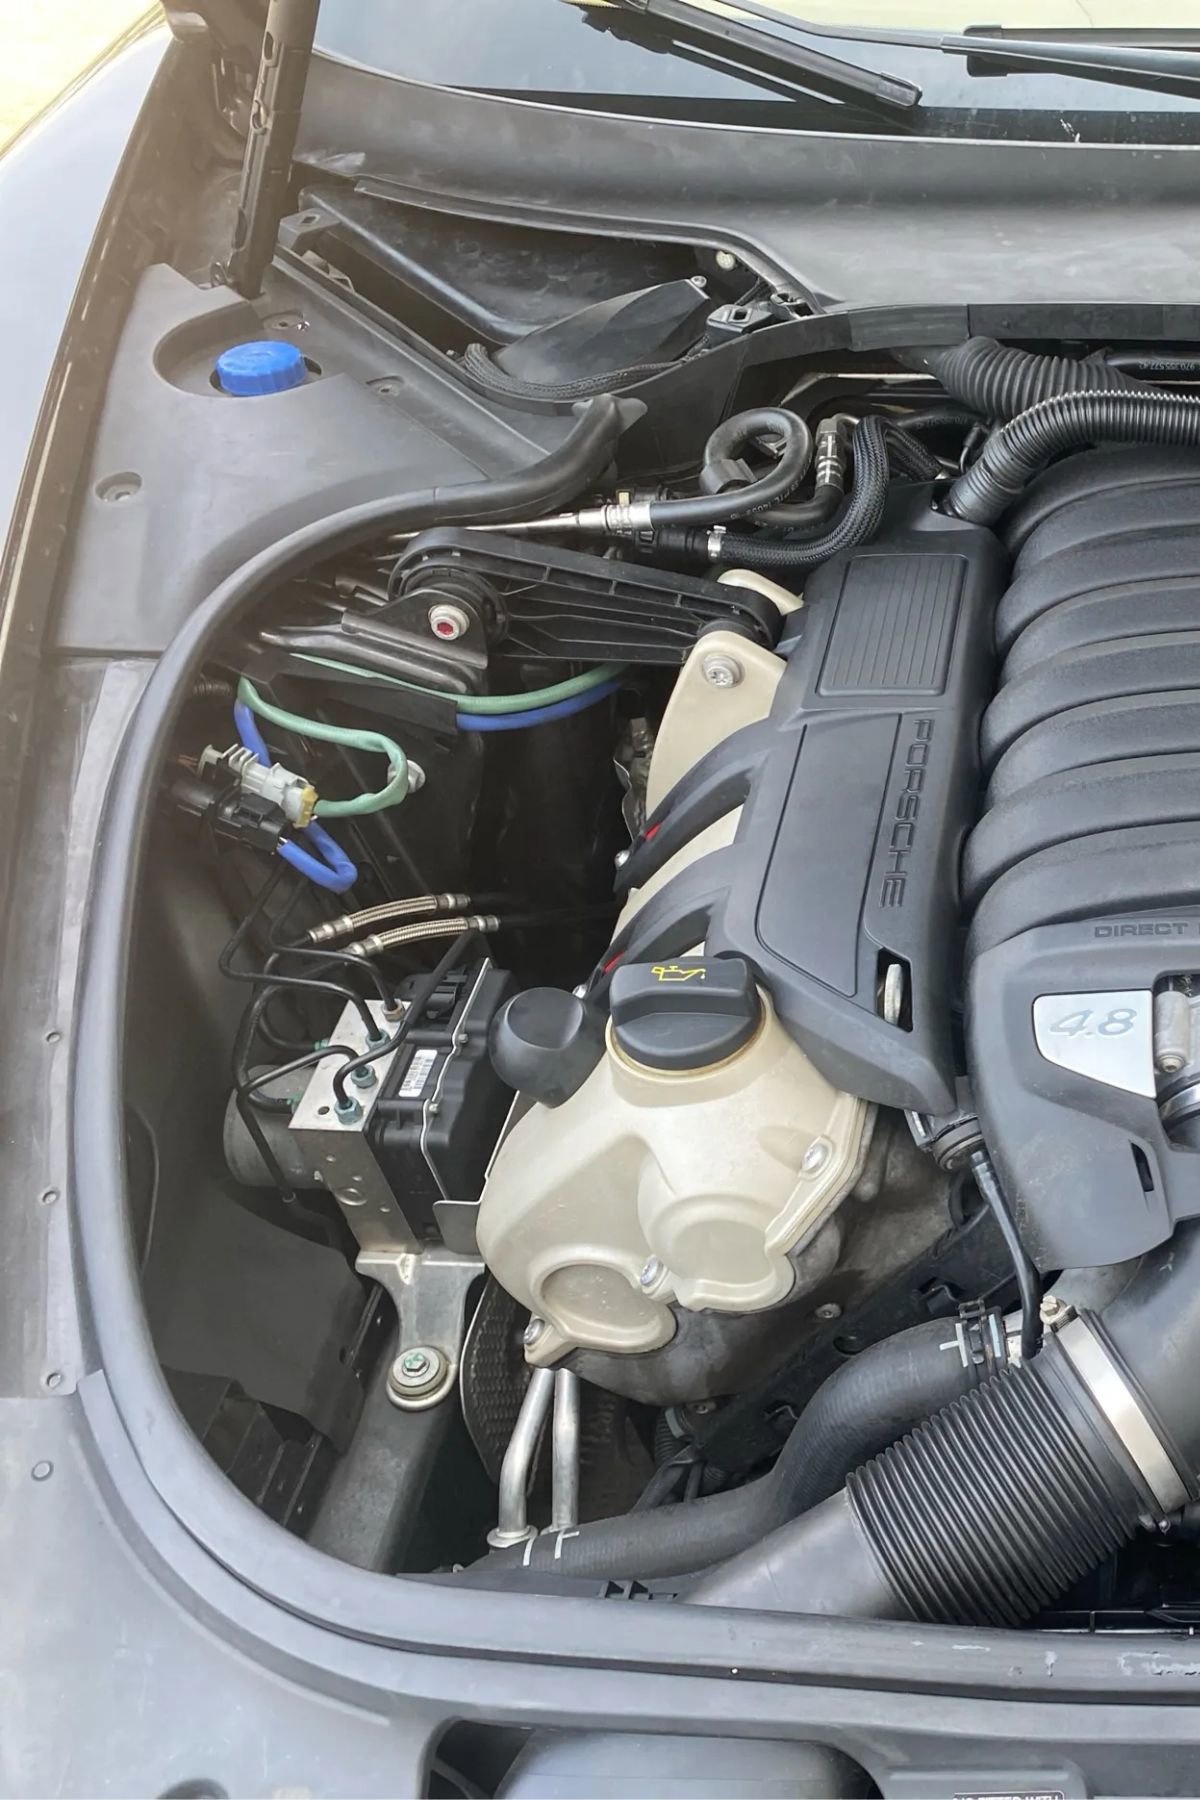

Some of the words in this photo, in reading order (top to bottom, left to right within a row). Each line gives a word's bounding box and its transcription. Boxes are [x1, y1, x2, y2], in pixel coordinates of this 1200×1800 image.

[880, 719, 935, 907] PORSCHE
[1094, 922, 1188, 938] DIRECT
[1049, 1008, 1137, 1037] 4.8
